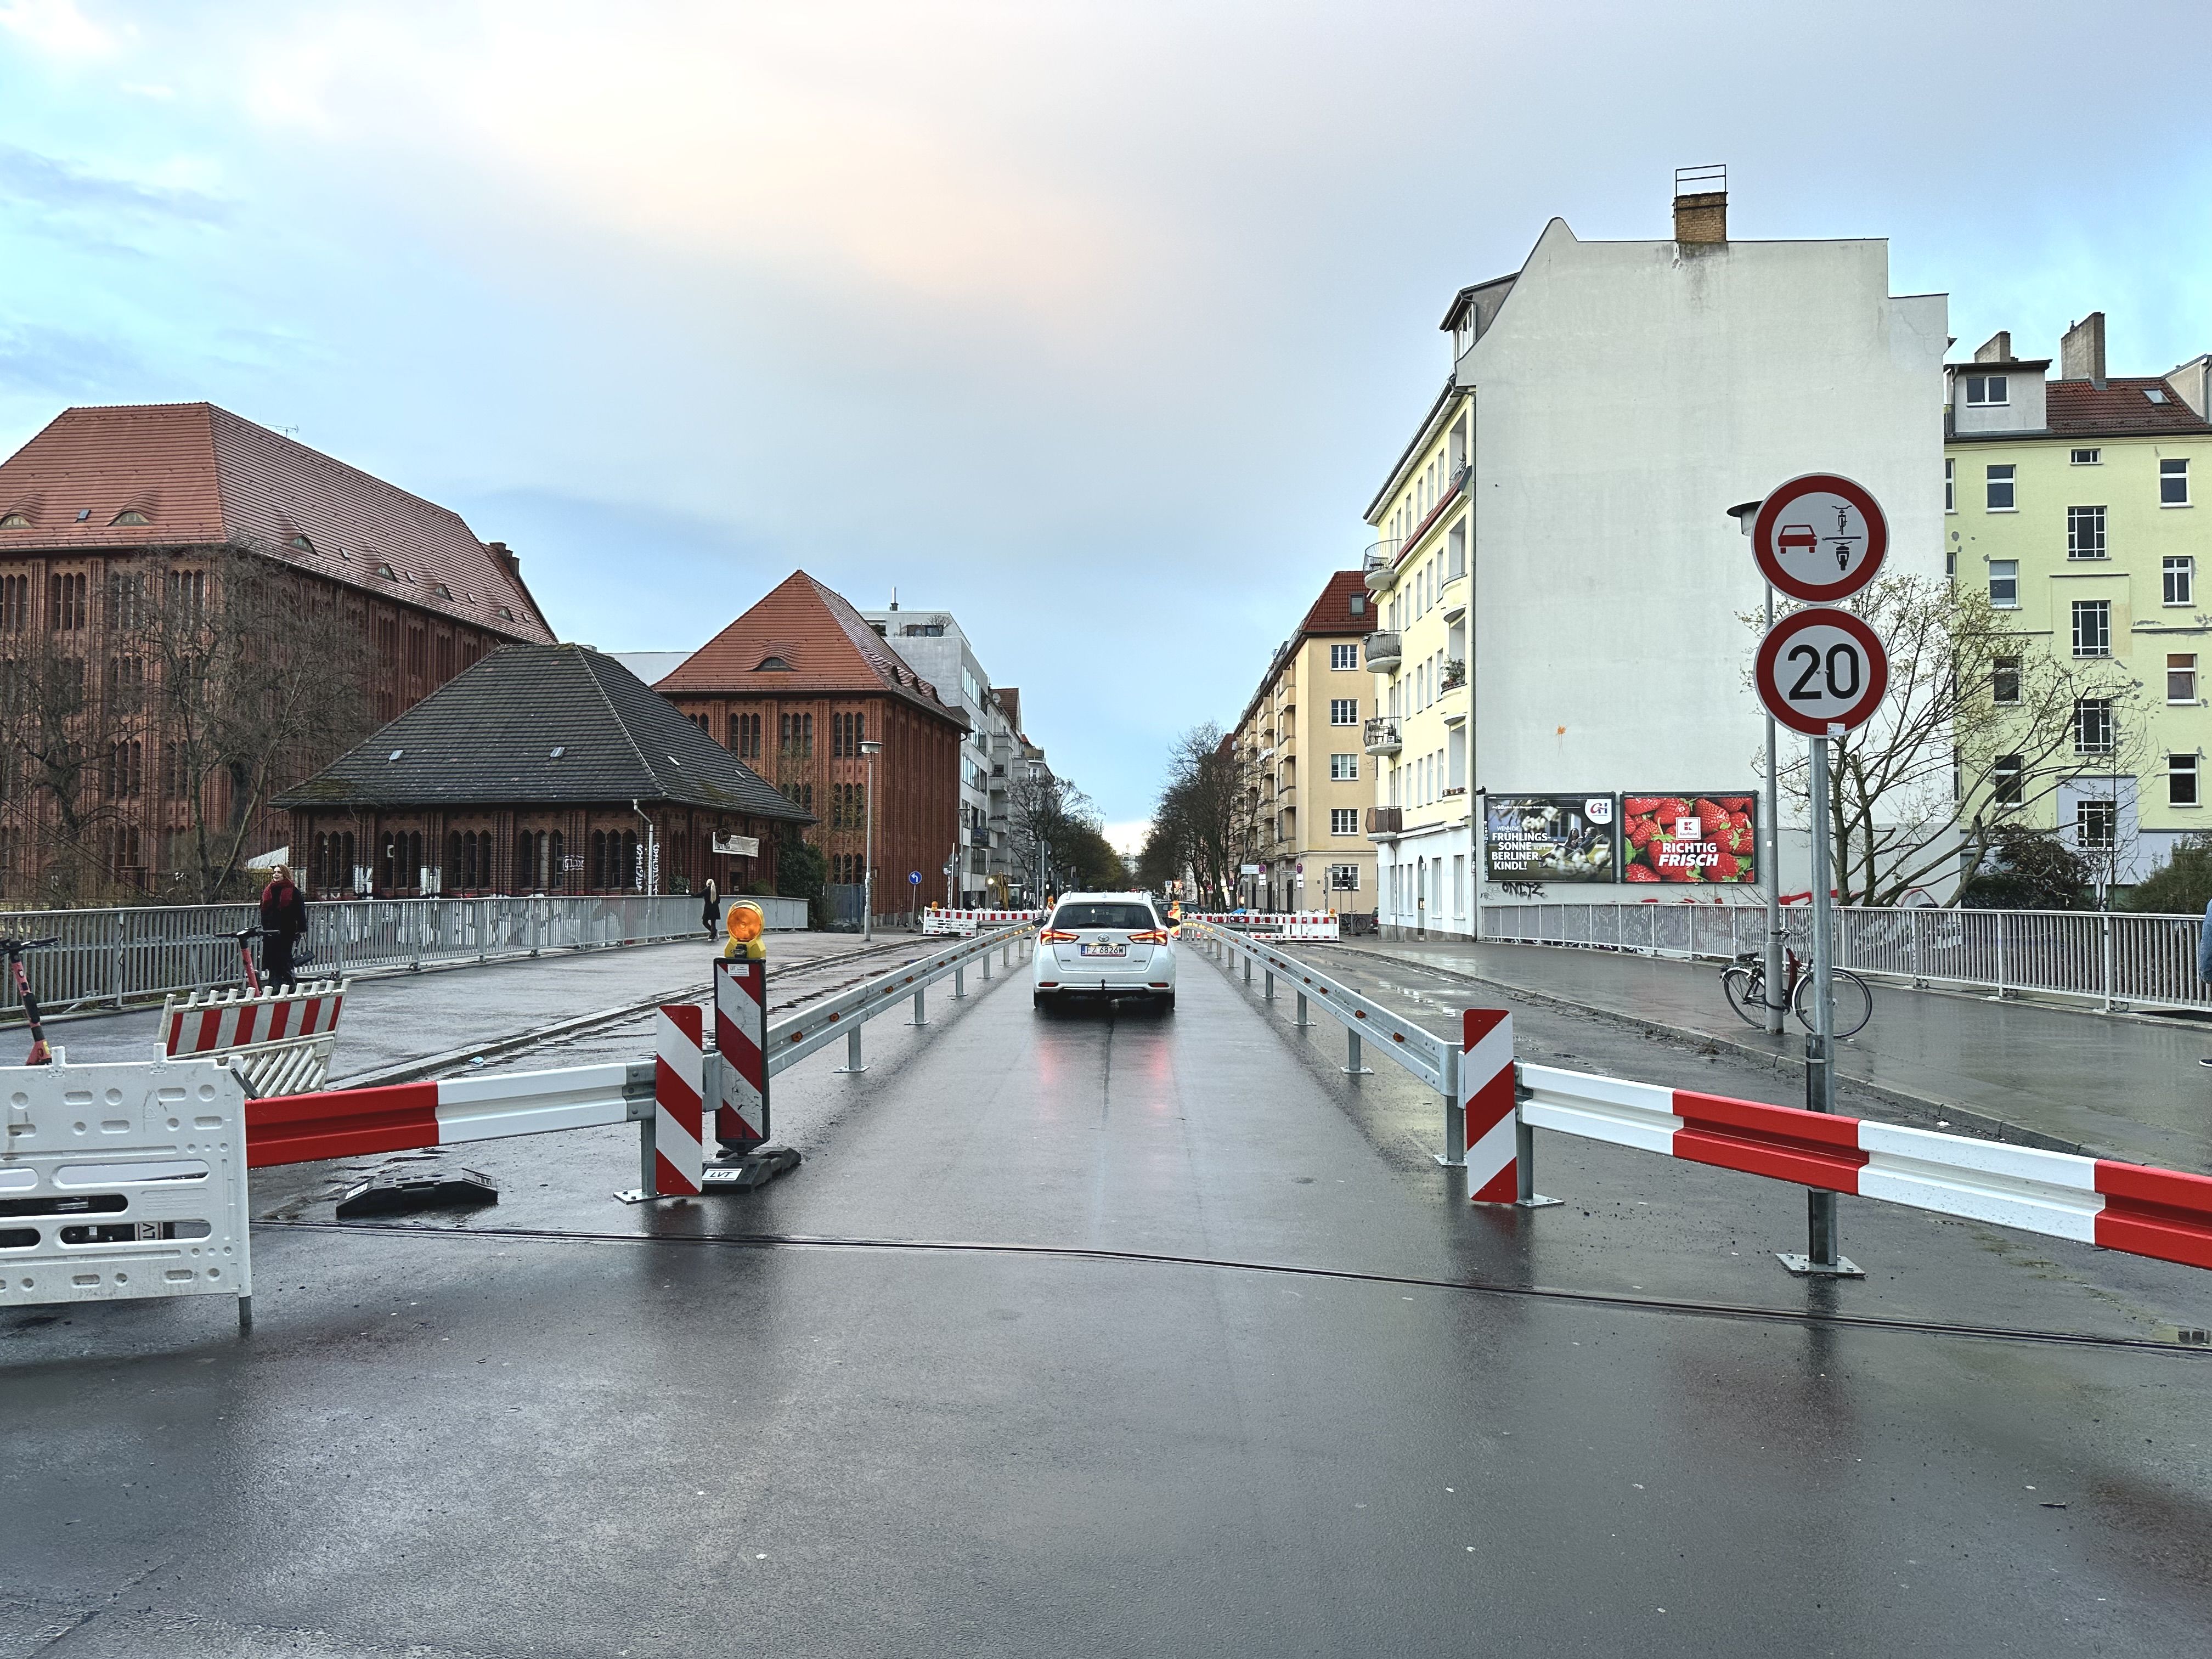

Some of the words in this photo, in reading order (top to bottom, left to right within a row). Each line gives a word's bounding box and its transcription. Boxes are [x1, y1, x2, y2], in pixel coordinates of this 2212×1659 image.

[1788, 644, 1860, 700] 20
[1492, 831, 1551, 841] FRÜHLINGS-
[1498, 842, 1532, 851] SONNE
[1662, 842, 1717, 853] RICHTIG
[1658, 854, 1719, 867] FRISCH
[1493, 861, 1527, 871] KINDL!
[1086, 946, 1097, 954] FZ
[1099, 946, 1124, 954] 6826W
[143, 1223, 155, 1239] LV
